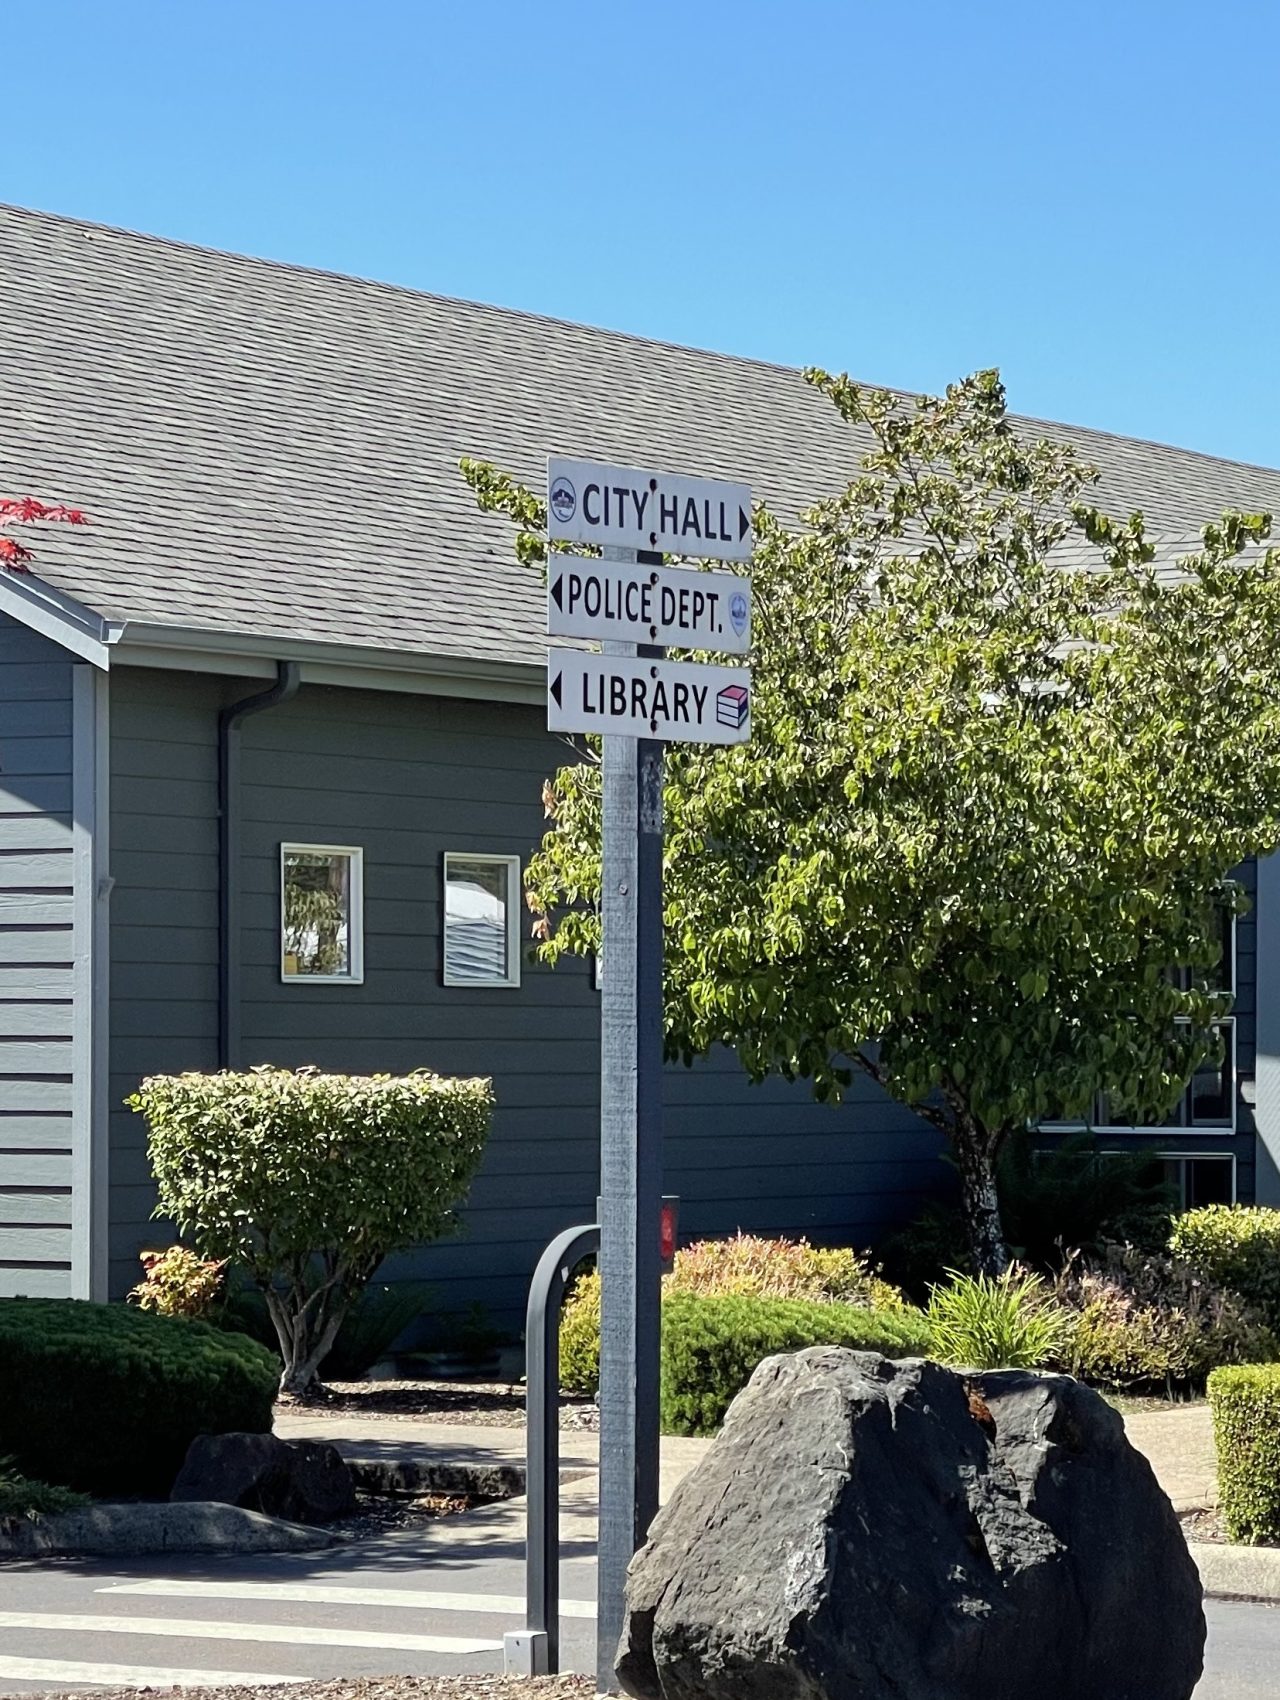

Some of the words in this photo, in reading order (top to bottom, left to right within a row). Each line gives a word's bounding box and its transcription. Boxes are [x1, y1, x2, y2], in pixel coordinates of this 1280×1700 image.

[583, 483, 649, 531] CITY
[660, 493, 732, 542] HALL
[569, 574, 652, 623] POLICE
[661, 586, 722, 633] DEPT.
[583, 672, 708, 724] LIBRARY
